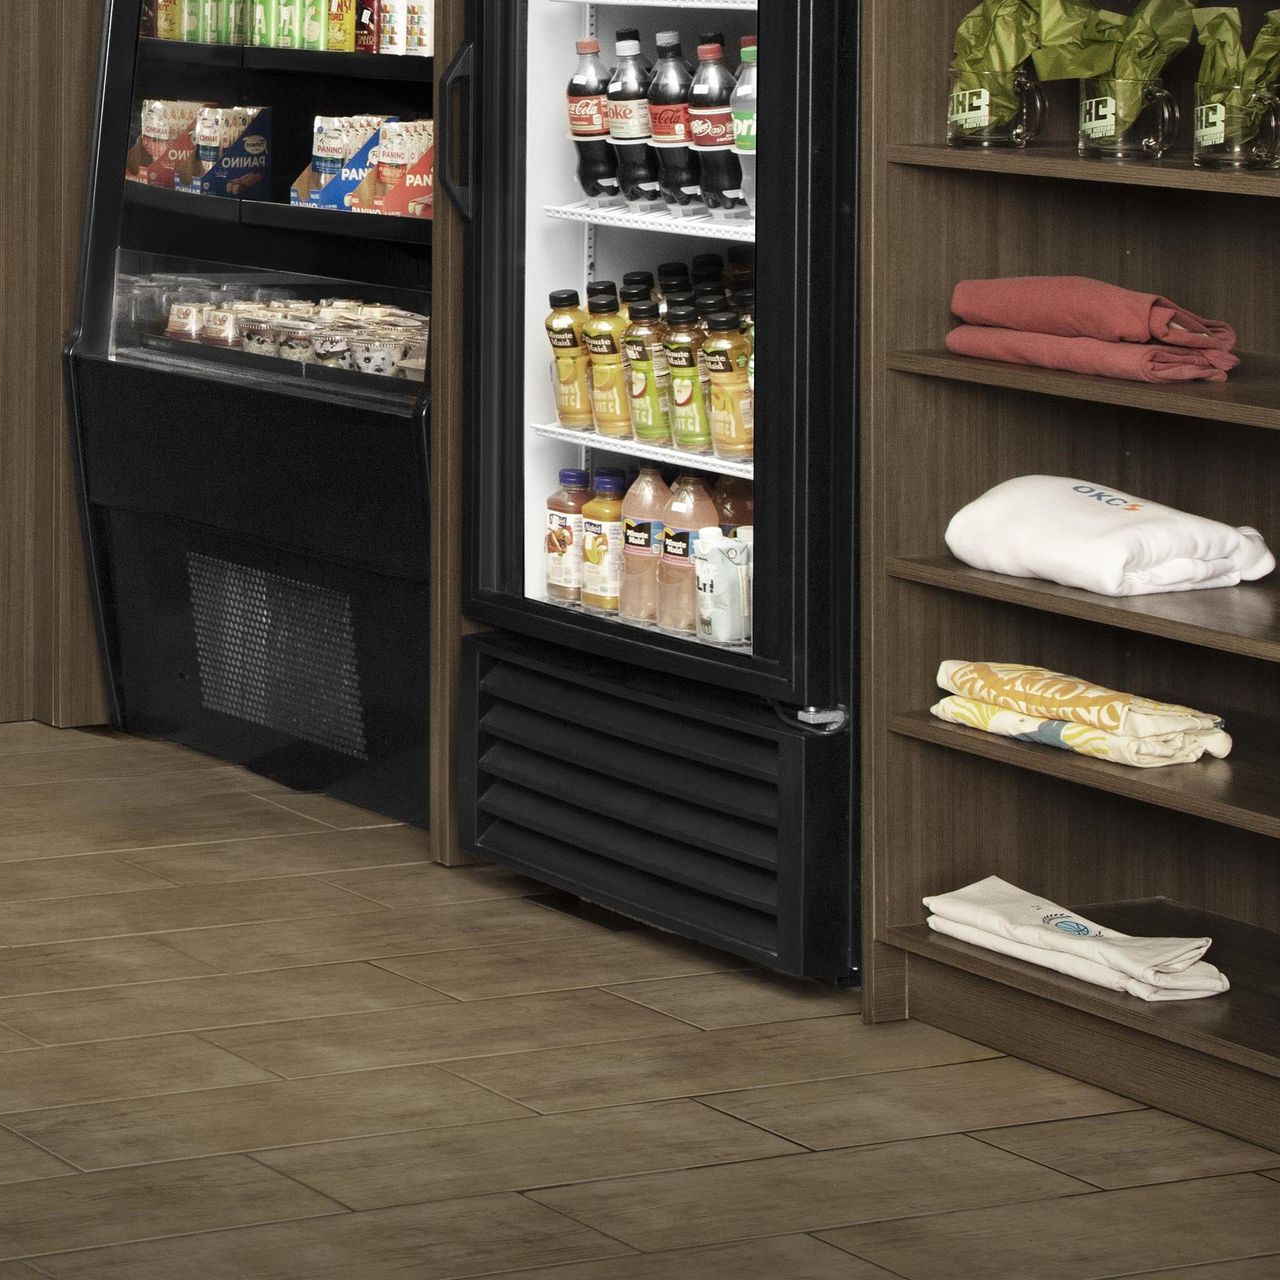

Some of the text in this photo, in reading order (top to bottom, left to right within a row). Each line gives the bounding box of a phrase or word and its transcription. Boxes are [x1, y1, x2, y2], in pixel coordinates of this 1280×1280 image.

[608, 104, 632, 119] oke
[316, 145, 343, 156] PANINO
[381, 150, 405, 160] PANINO
[1072, 484, 1130, 508] OKC
[626, 529, 648, 539] Minute
[628, 537, 645, 545] Maid
[665, 538, 687, 549] Minute
[667, 546, 683, 555] Maid
